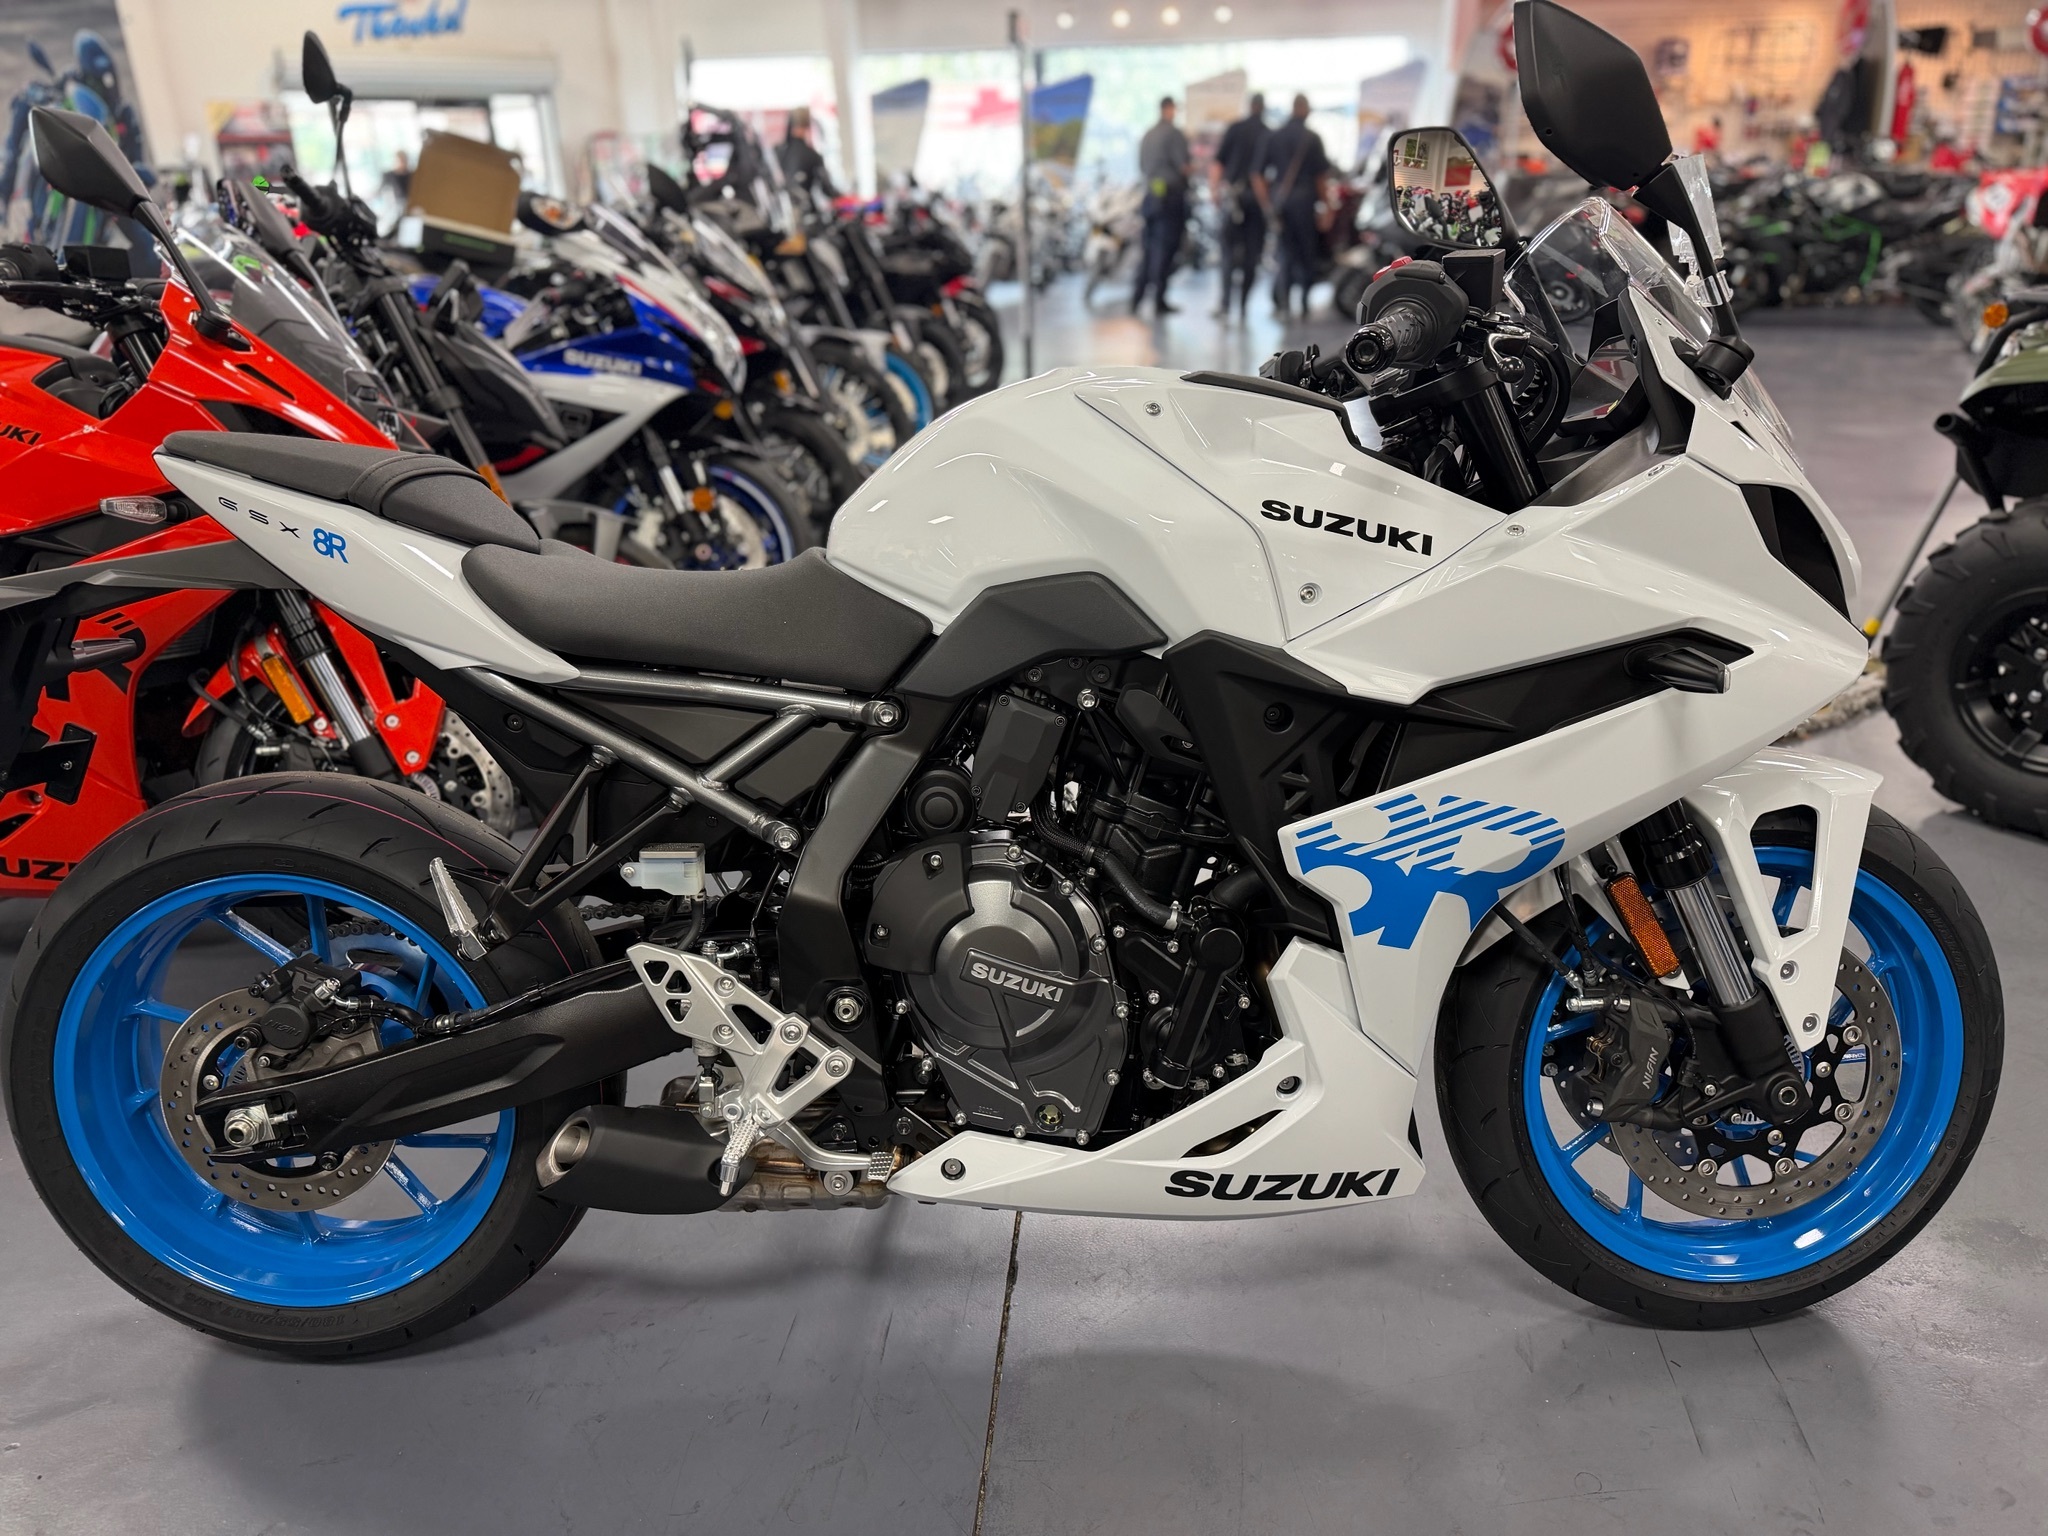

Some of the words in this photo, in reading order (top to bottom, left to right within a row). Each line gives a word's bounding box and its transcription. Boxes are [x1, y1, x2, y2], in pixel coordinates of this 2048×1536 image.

[313, 527, 349, 564] 8R
[1260, 499, 1433, 556] SUZUKI
[970, 962, 1064, 1003] SUZUKI
[1165, 1167, 1401, 1200] SUZUKI
